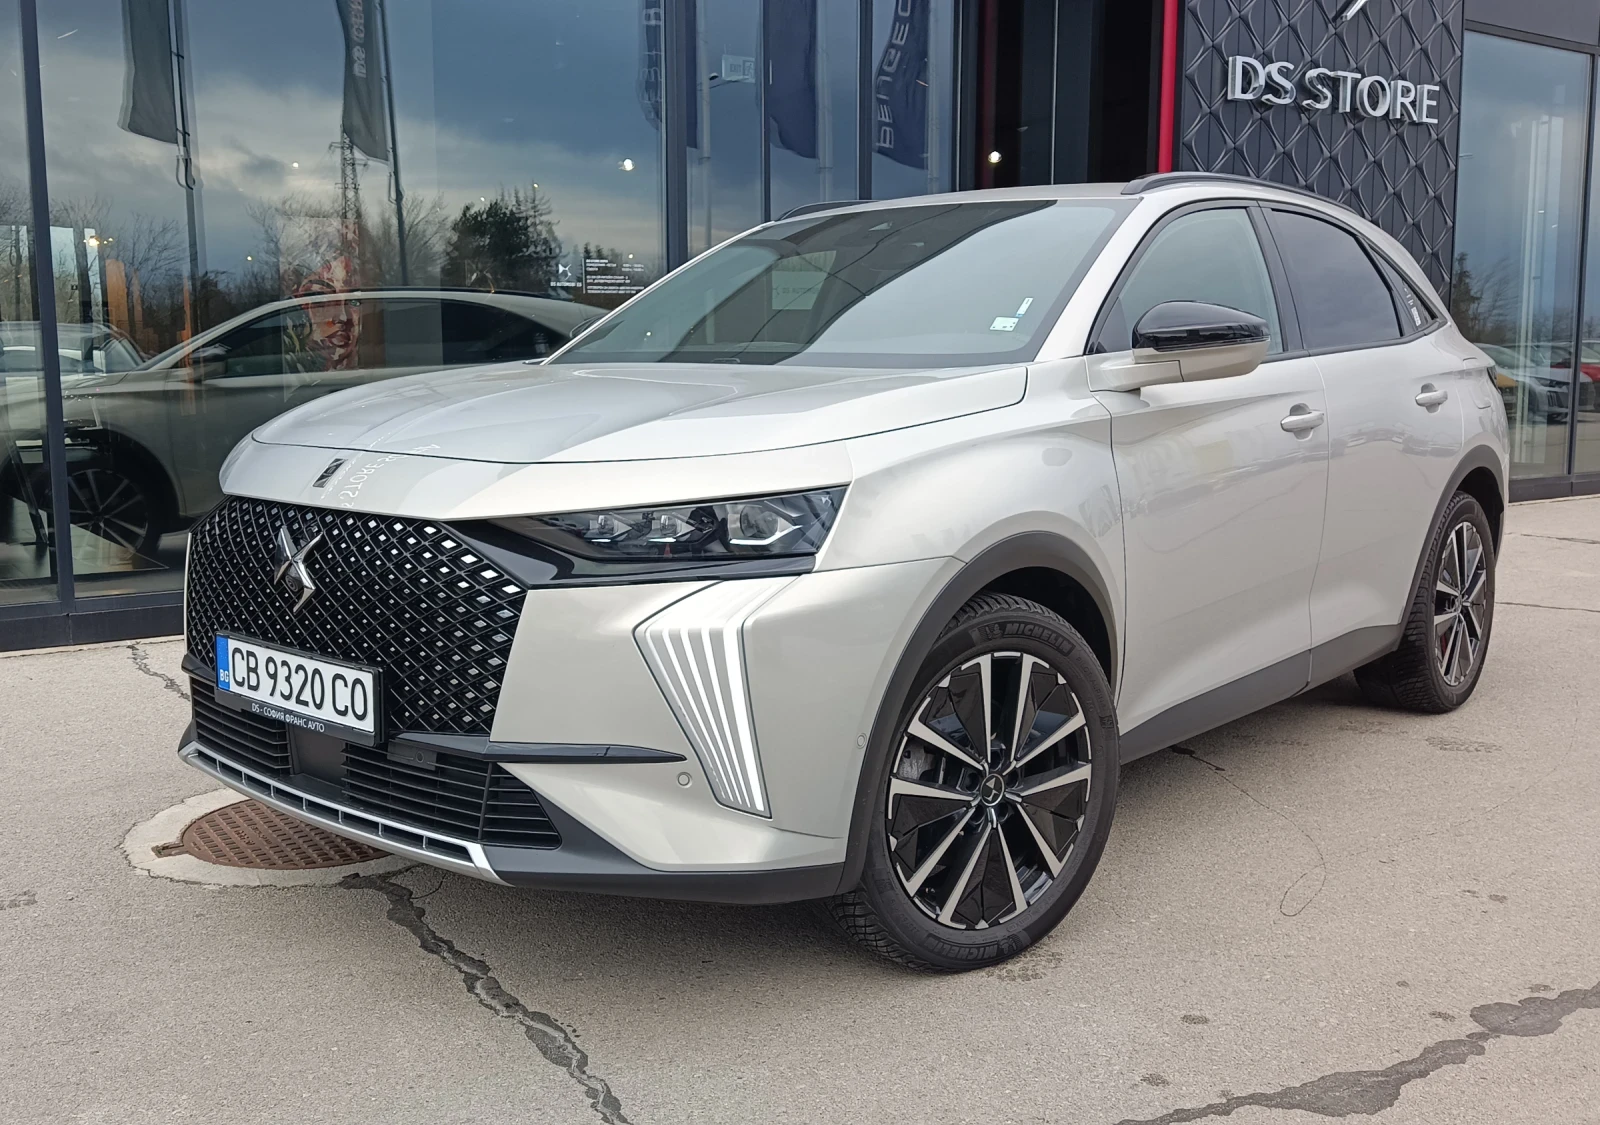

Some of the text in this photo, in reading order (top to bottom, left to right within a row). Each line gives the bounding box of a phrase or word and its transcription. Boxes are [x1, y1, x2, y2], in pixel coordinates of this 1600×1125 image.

[729, 63, 742, 74] EXIT
[1228, 55, 1440, 124] DS STORE
[1004, 623, 1073, 654] MICHELIN
[220, 669, 229, 682] BG
[232, 647, 368, 720] CB 9320 CO
[252, 703, 260, 713] DS
[264, 706, 284, 720] СОФИЯ
[285, 714, 307, 728] ФРАНС
[307, 720, 325, 732] АУТО
[925, 935, 998, 961] MICHELIN
